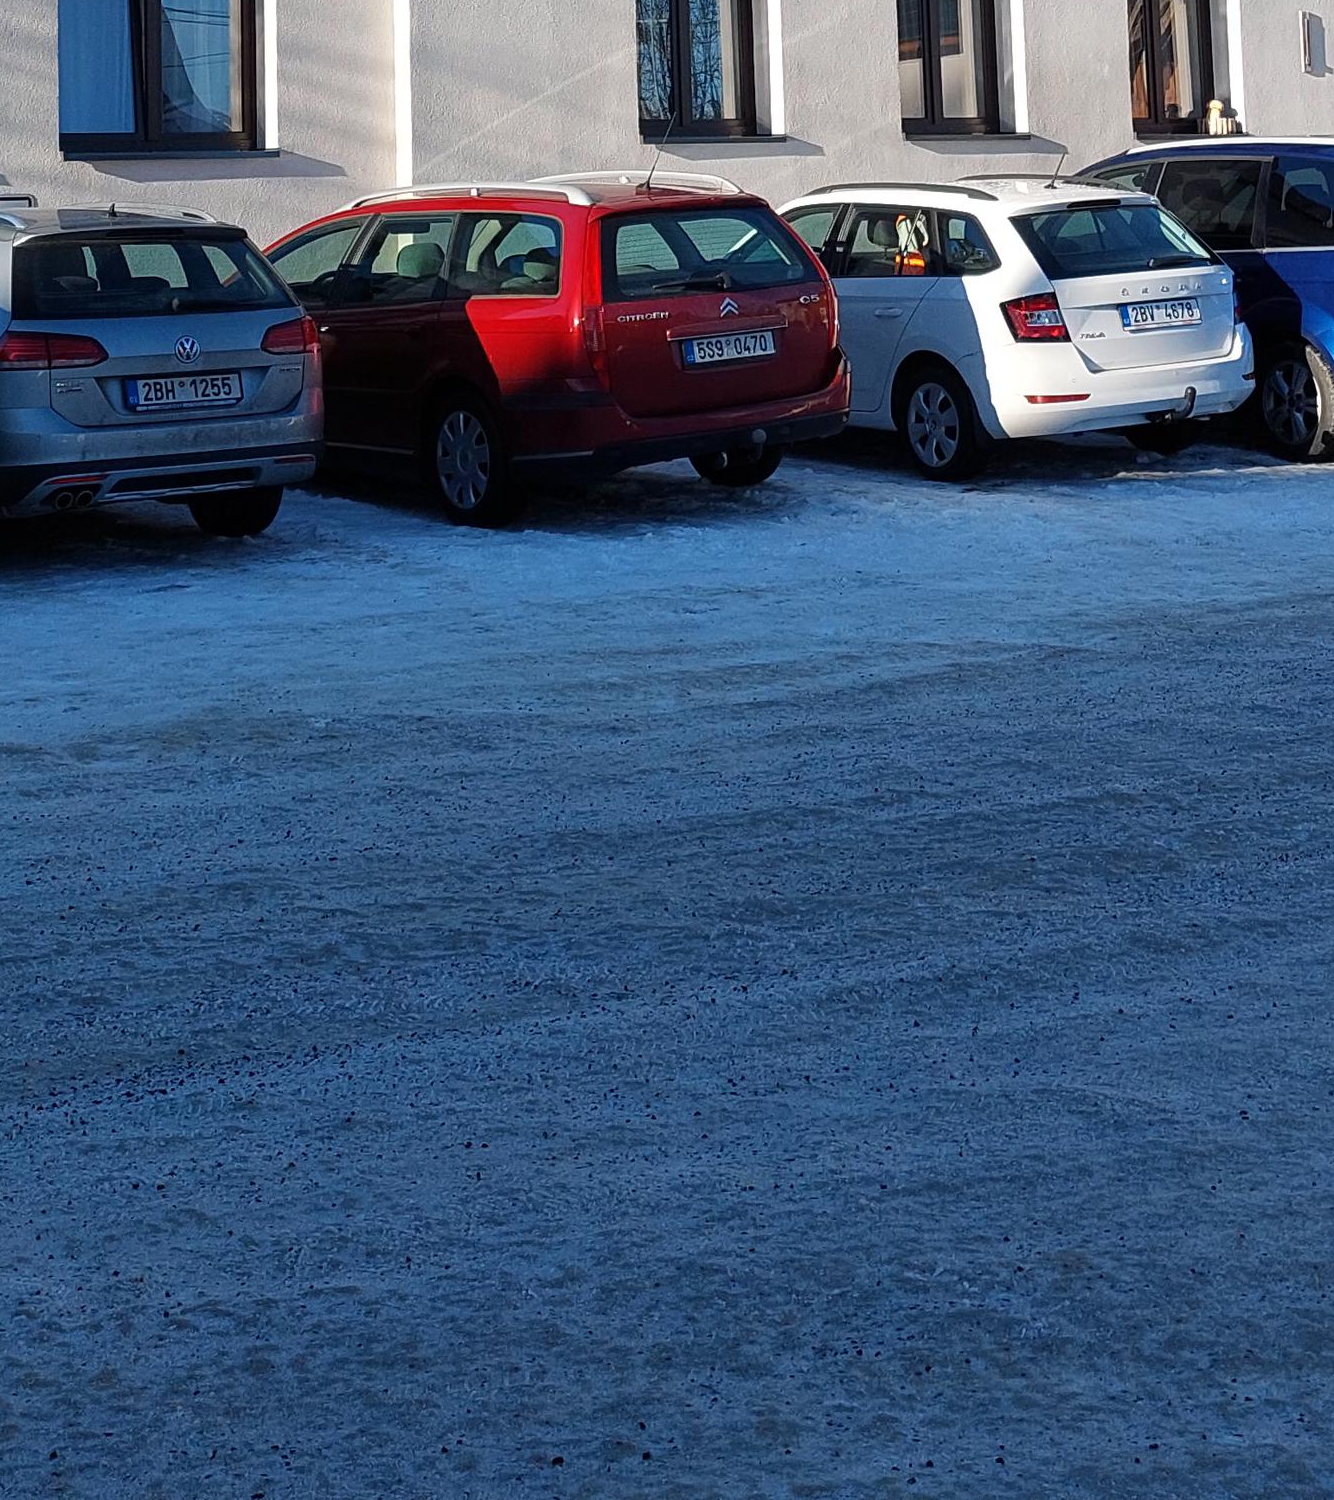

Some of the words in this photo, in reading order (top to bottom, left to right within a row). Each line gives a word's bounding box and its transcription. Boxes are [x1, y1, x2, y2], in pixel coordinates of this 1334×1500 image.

[799, 294, 820, 304] C5
[1131, 306, 1155, 324] 2BV
[1164, 301, 1195, 320] 4678
[696, 338, 724, 360] 5S9
[733, 334, 767, 356] 0470
[142, 380, 176, 402] 2BH
[189, 376, 232, 399] 1255
